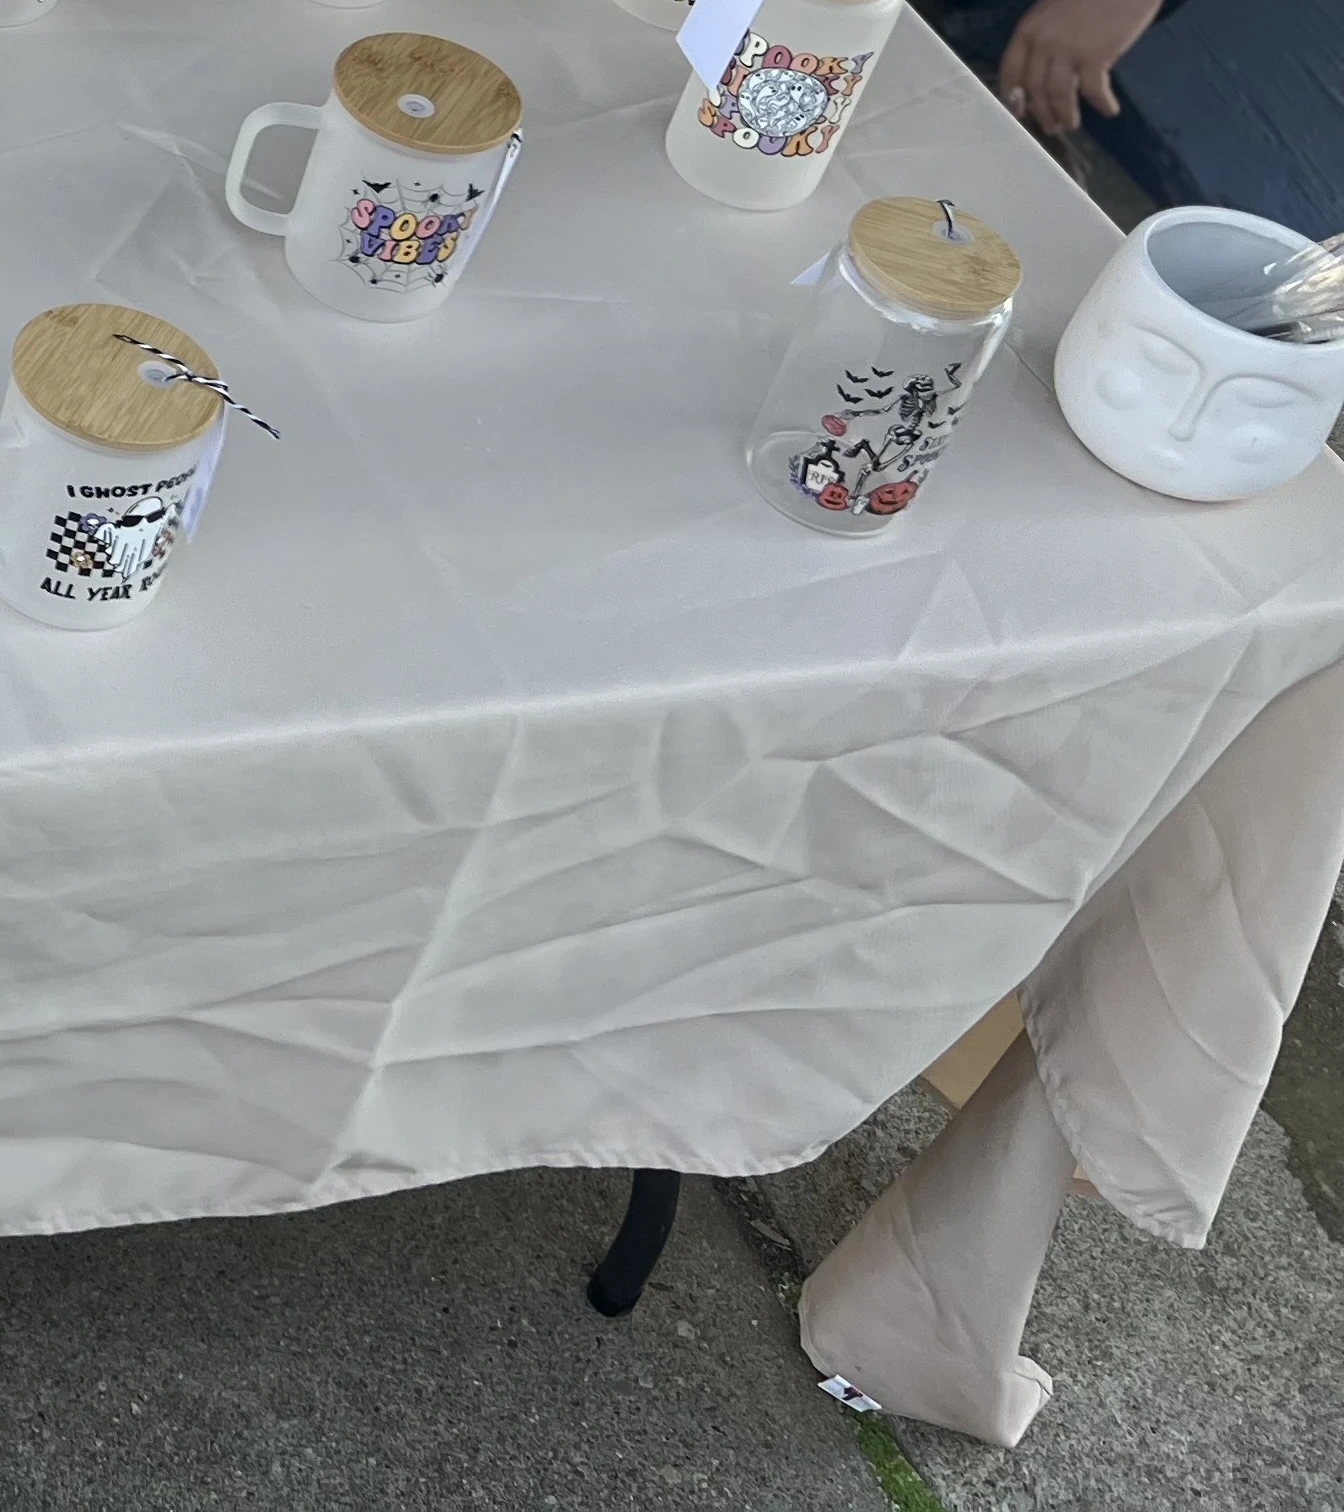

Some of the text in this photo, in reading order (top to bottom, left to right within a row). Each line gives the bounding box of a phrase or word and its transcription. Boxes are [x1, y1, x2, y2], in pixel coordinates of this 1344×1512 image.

[734, 28, 874, 76] POOKY
[697, 98, 841, 158] SPOOKY
[351, 198, 478, 241] SPOOKY
[360, 230, 461, 265] VIBES
[66, 484, 76, 498] I
[79, 482, 153, 499] GHOST
[40, 576, 133, 602] ALL YEAR
